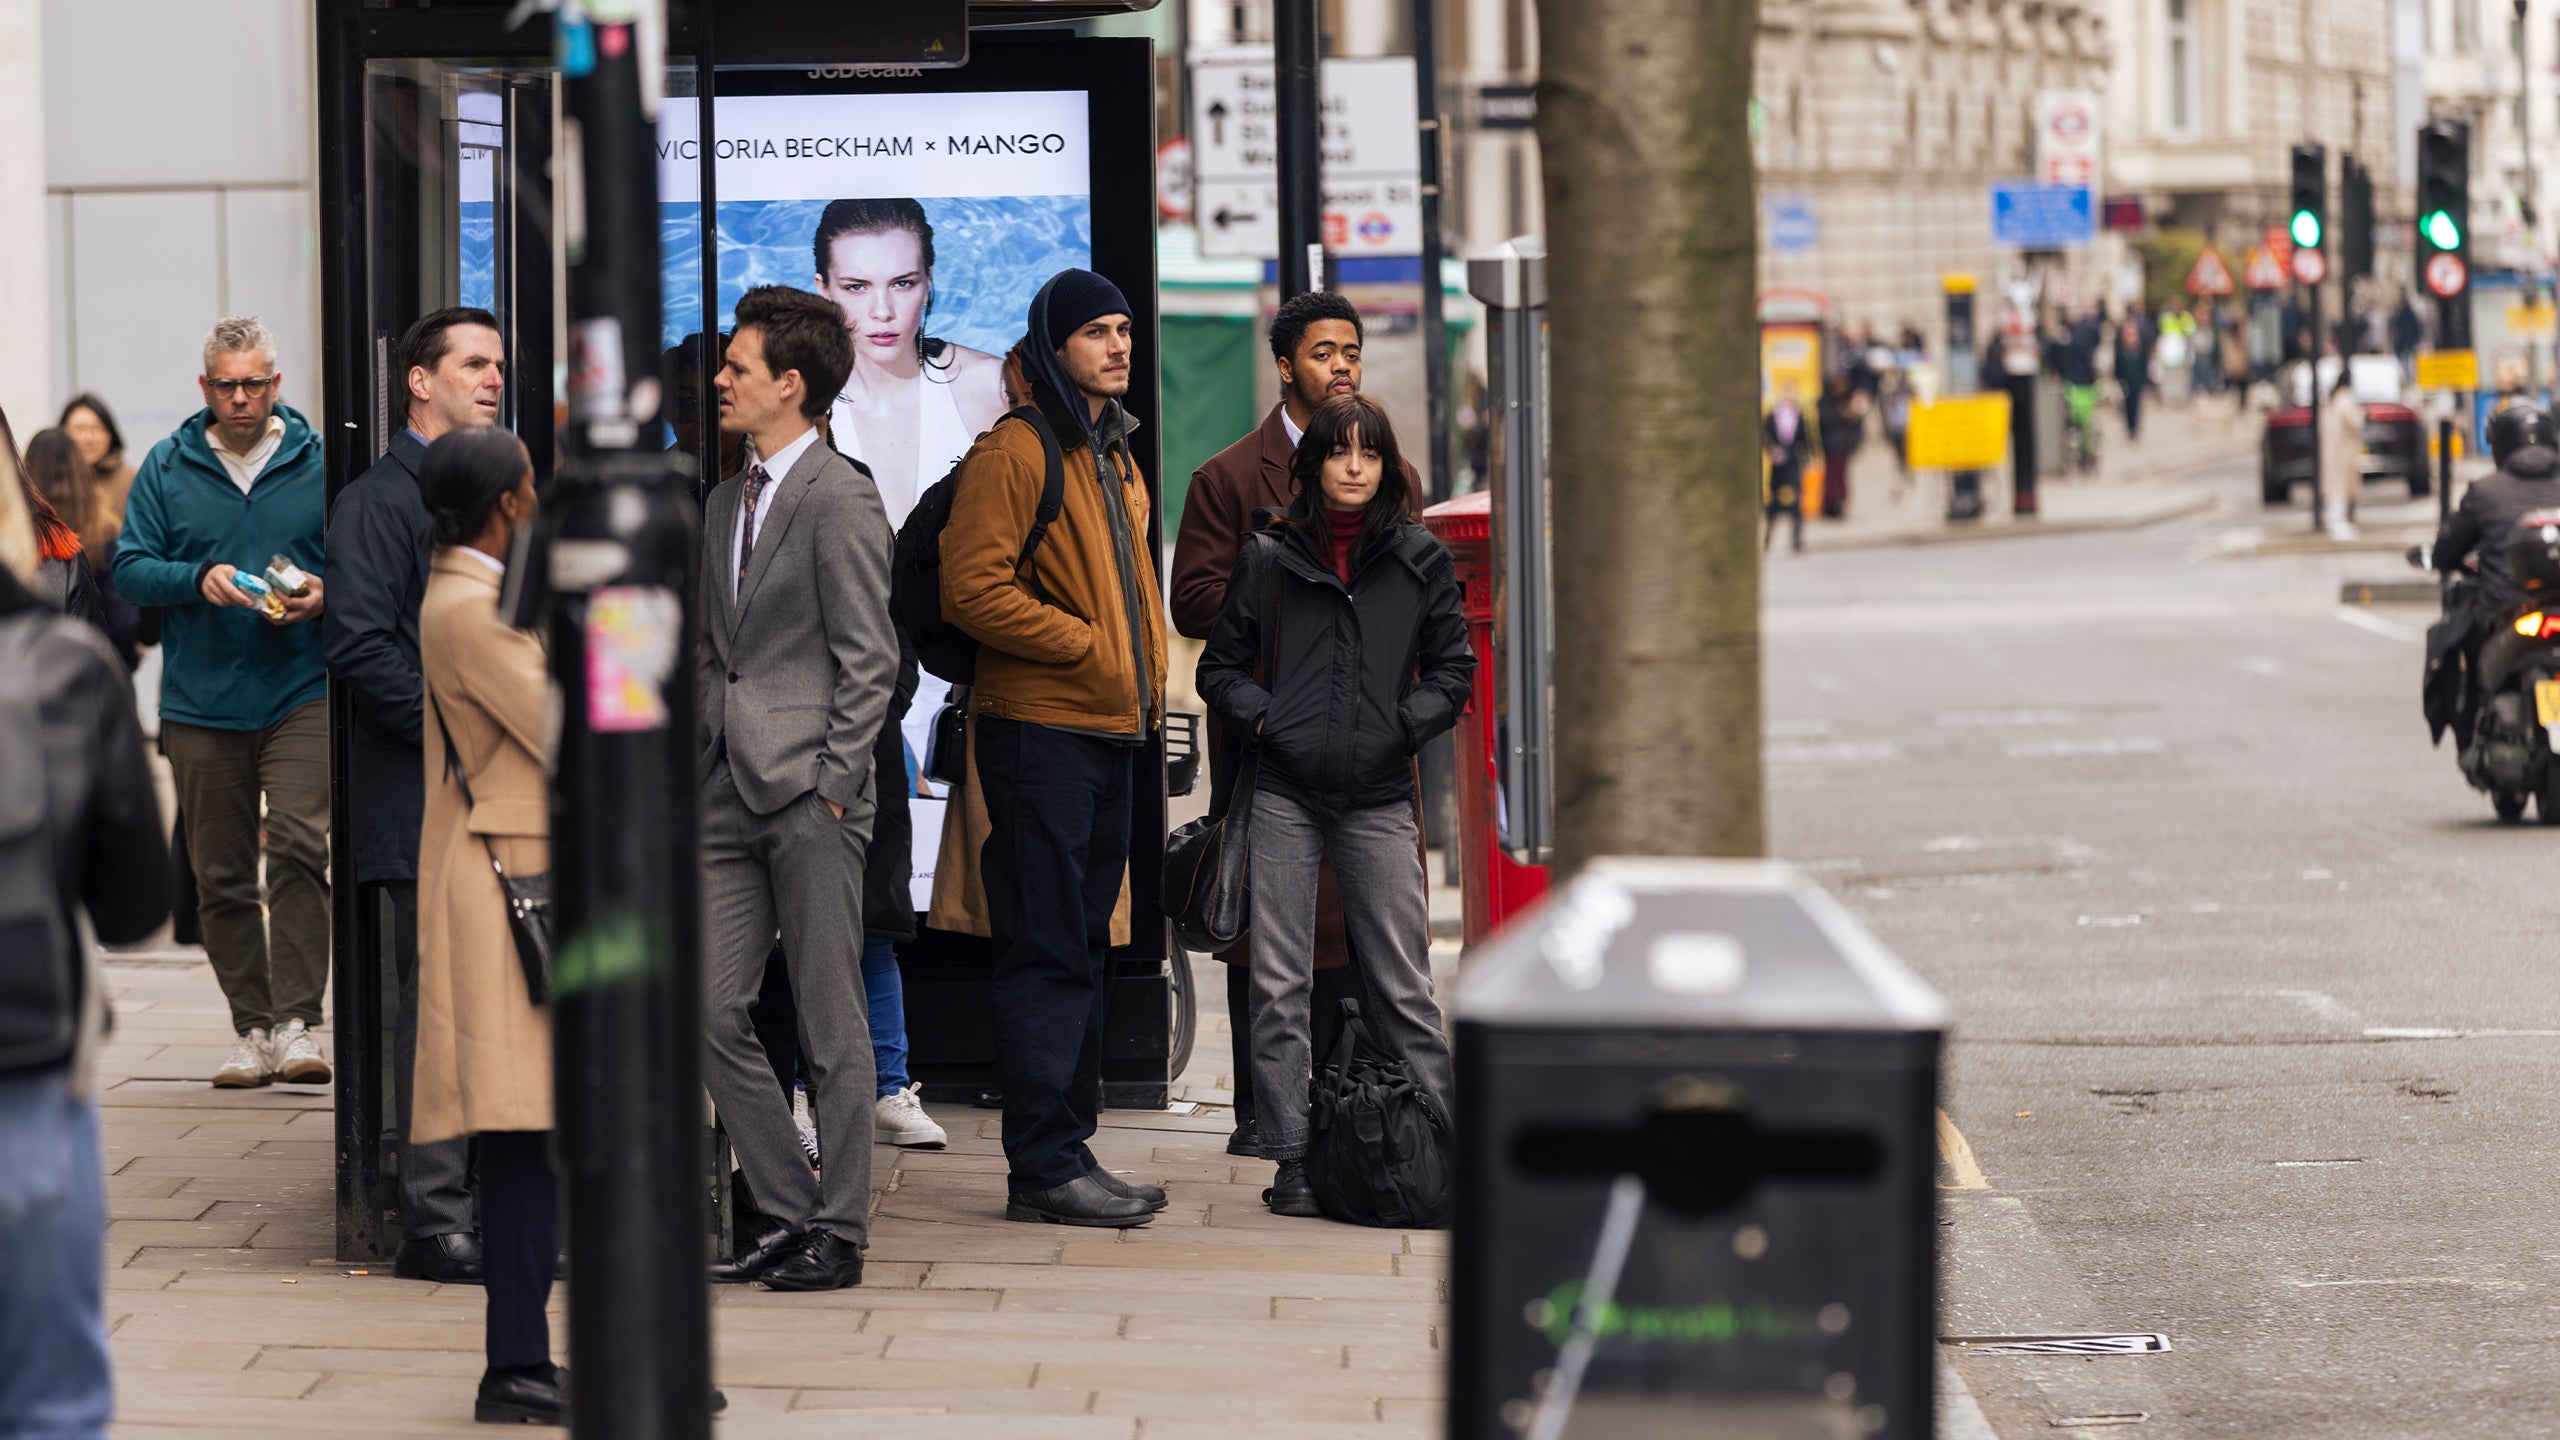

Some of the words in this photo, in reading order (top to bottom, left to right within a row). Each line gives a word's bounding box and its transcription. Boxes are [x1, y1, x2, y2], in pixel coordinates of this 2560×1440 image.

[656, 139, 779, 160] VICORIA
[785, 136, 913, 158] BECKHAM
[948, 134, 1065, 155] MANGO
